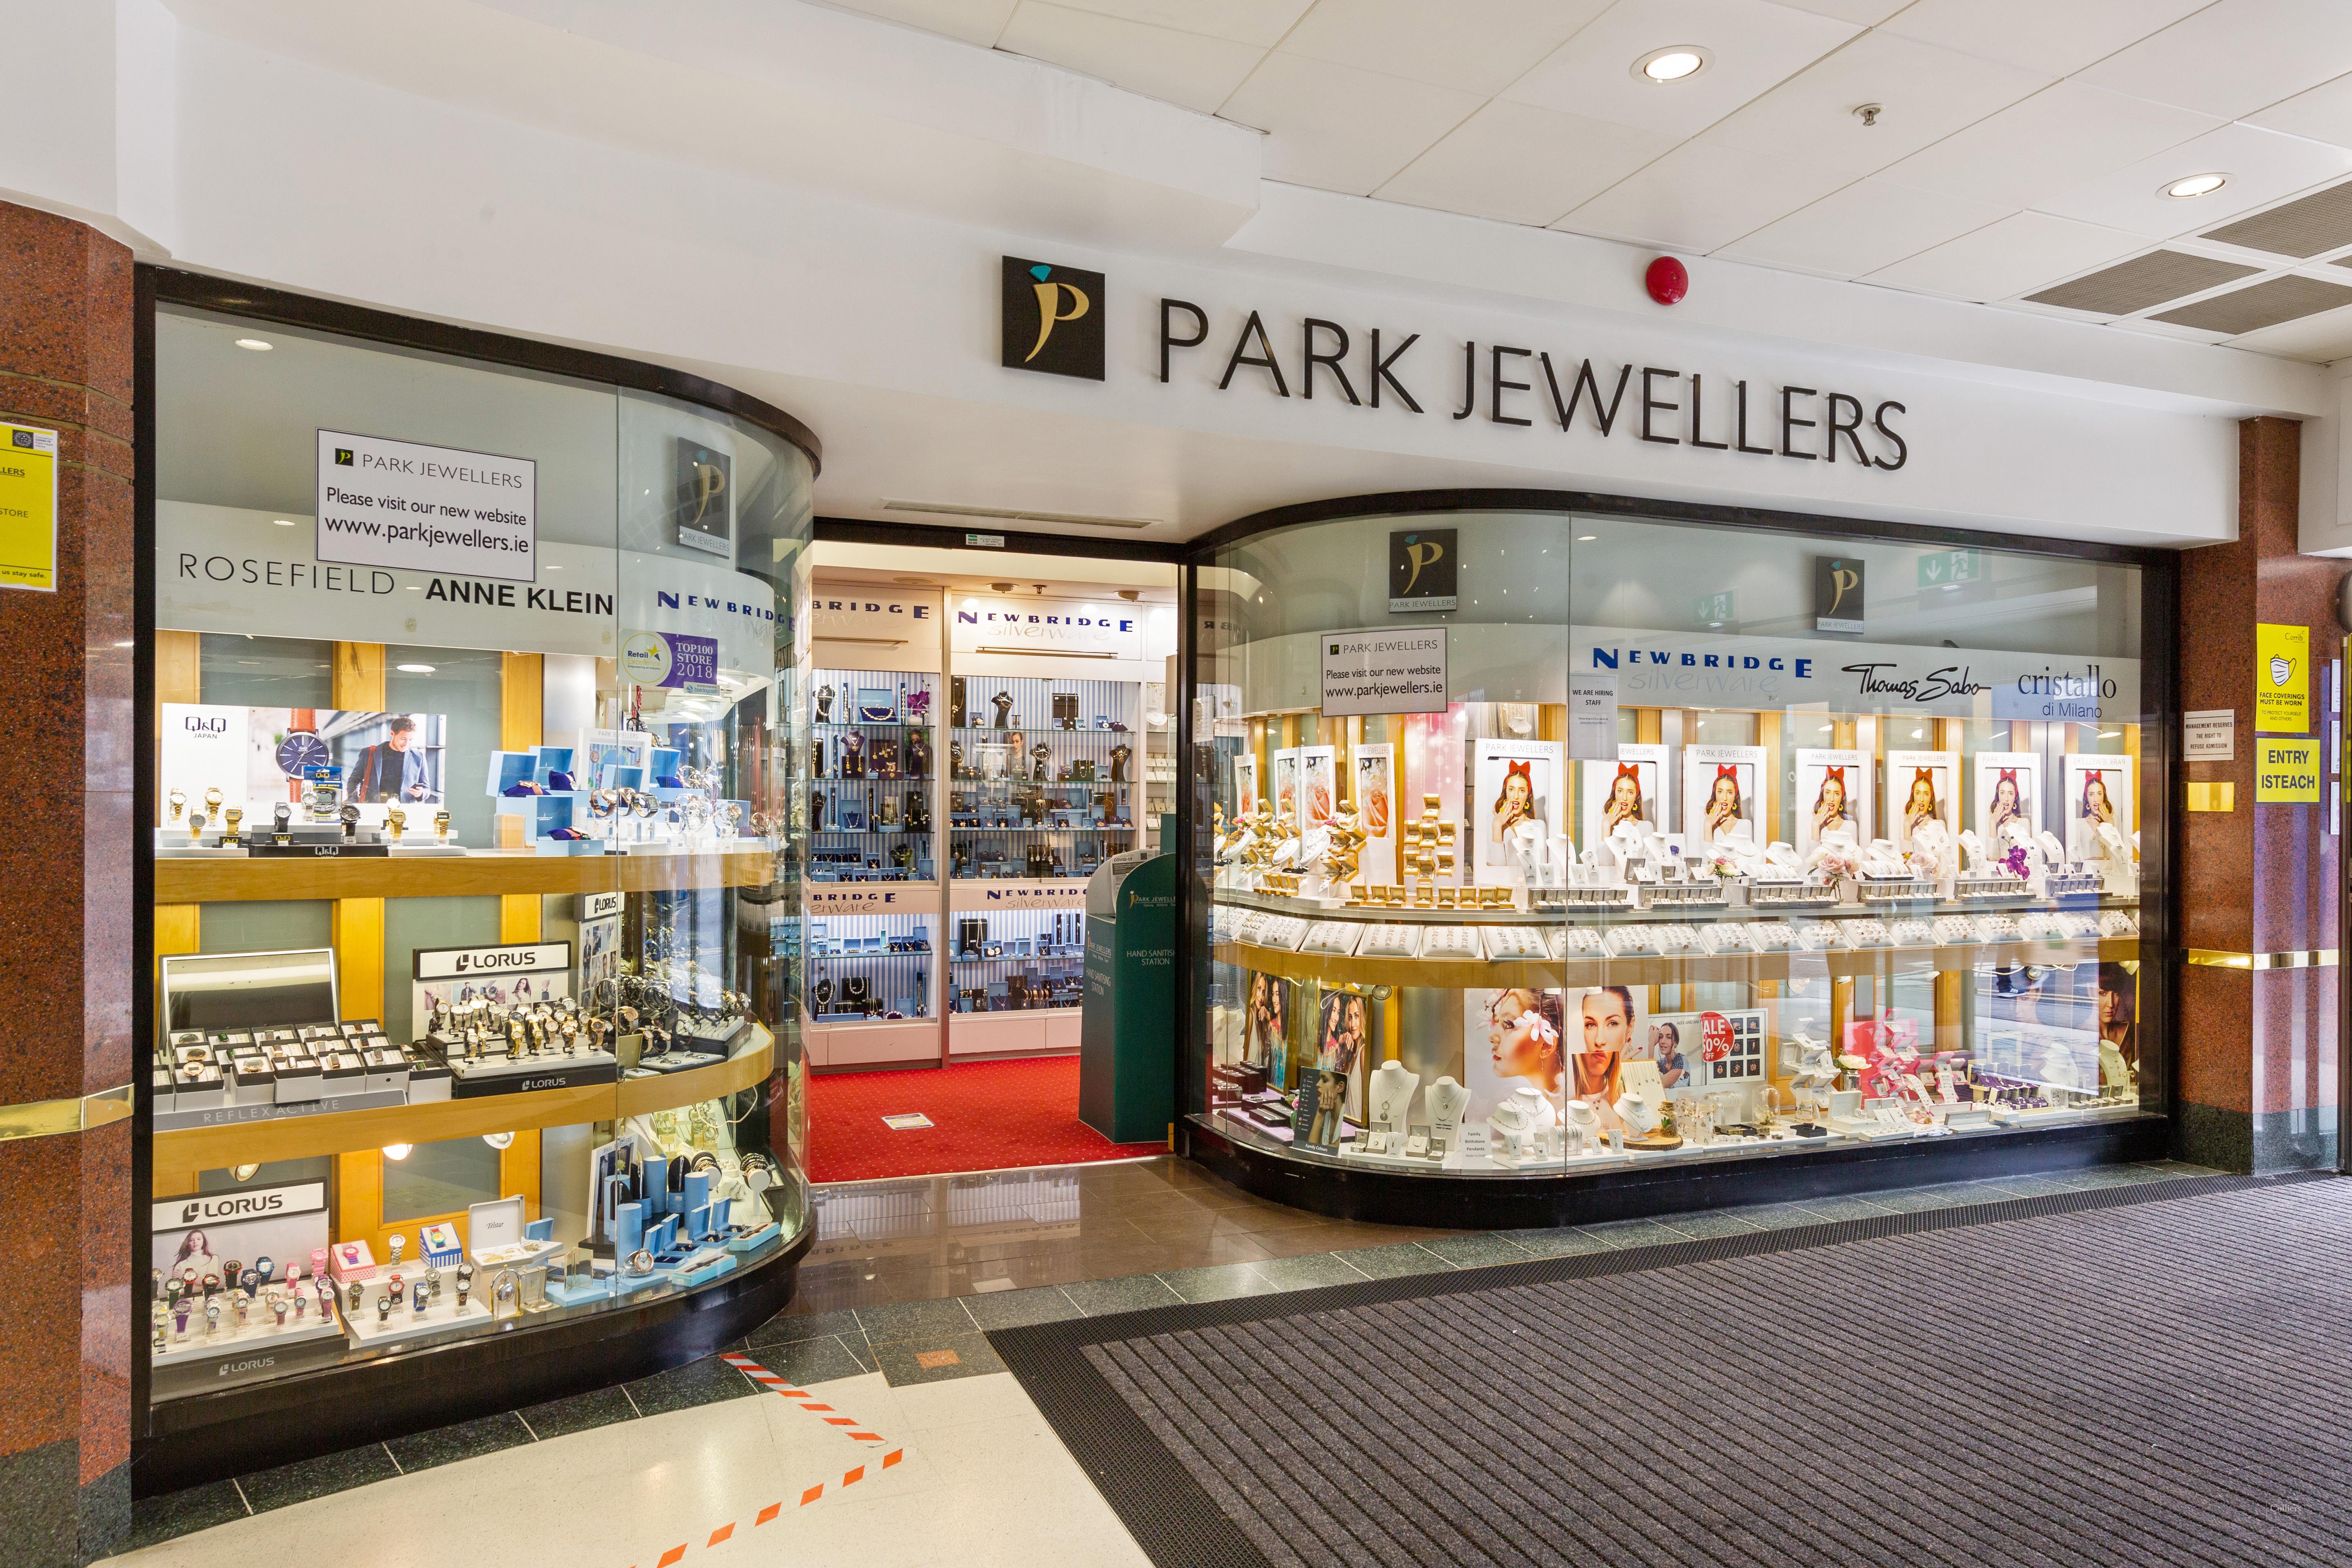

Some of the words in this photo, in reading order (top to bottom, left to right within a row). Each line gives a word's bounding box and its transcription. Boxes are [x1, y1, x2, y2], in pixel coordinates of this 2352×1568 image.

[1161, 298, 1425, 414] PARK
[1453, 341, 1908, 471] JEWELLERS
[363, 454, 414, 474] PARK
[420, 462, 522, 488] JEWELLERS
[327, 487, 373, 507] Please
[378, 495, 407, 511] visit
[411, 502, 436, 514] our
[440, 506, 470, 518] new
[474, 508, 526, 526] website
[325, 517, 529, 553] www.parkjewellers.ie
[680, 531, 696, 543] PARK
[698, 536, 729, 552] JEWELLERS
[180, 553, 395, 594] ROSEFIELD
[425, 578, 515, 607] ANNE
[528, 587, 613, 615] KLEIN
[657, 590, 796, 633] NEWBRIDGE
[813, 600, 929, 619] BRIDGE
[1412, 599, 1456, 608] JEWELLERS
[958, 610, 1133, 632] NEWBRIDGE
[2285, 633, 2303, 641] Corrib
[676, 642, 713, 655] TOP100
[1343, 644, 1371, 654] PARK
[1374, 640, 1438, 652] JEWELLERS
[627, 657, 661, 667] Excellence
[677, 653, 712, 665] STORE
[1593, 648, 1812, 679] NEWBRIDGE
[677, 663, 713, 679] 2018
[1326, 669, 1350, 679] Please
[1352, 668, 1367, 677] visit
[1386, 668, 1405, 676] new
[1407, 664, 1441, 675] website
[1841, 663, 1919, 700] Thomas
[1915, 666, 1992, 702] Sabo
[2018, 664, 2117, 699] cristallo
[1325, 681, 1443, 700] www.parkjewellers.ie
[2042, 702, 2056, 716] di
[2059, 703, 2103, 719] Milano
[185, 717, 226, 733] Q&Q
[1367, 746, 1389, 755] JEWELLERS
[1486, 743, 1507, 752] PARK
[1509, 744, 1554, 754] JEWELLERS
[1619, 747, 1655, 755] JEWELLERS
[1696, 749, 1716, 757] PARK
[1717, 750, 1758, 759] JEWELLERS
[2268, 749, 2310, 765] ENTRY
[2261, 775, 2315, 790] ISTEACH
[315, 846, 339, 856] Q&Q
[813, 893, 896, 903] BRIDGE
[987, 889, 1087, 900] NEWBRID
[599, 897, 617, 911] LORUS
[811, 898, 876, 914] erware
[473, 951, 536, 969] LORUS
[1148, 949, 1176, 958] SANITISI
[1086, 967, 1094, 979] HAND
[1094, 971, 1111, 987] SANITISING
[1091, 982, 1104, 996] STATION
[1703, 1019, 1726, 1035] ALE
[532, 1078, 566, 1089] LORUS
[203, 1107, 270, 1124] REFLEX
[276, 1099, 340, 1116] ACTIVE
[205, 1194, 283, 1218] LORUS
[486, 1220, 504, 1230] Telstar
[231, 1357, 274, 1372] LORUS
